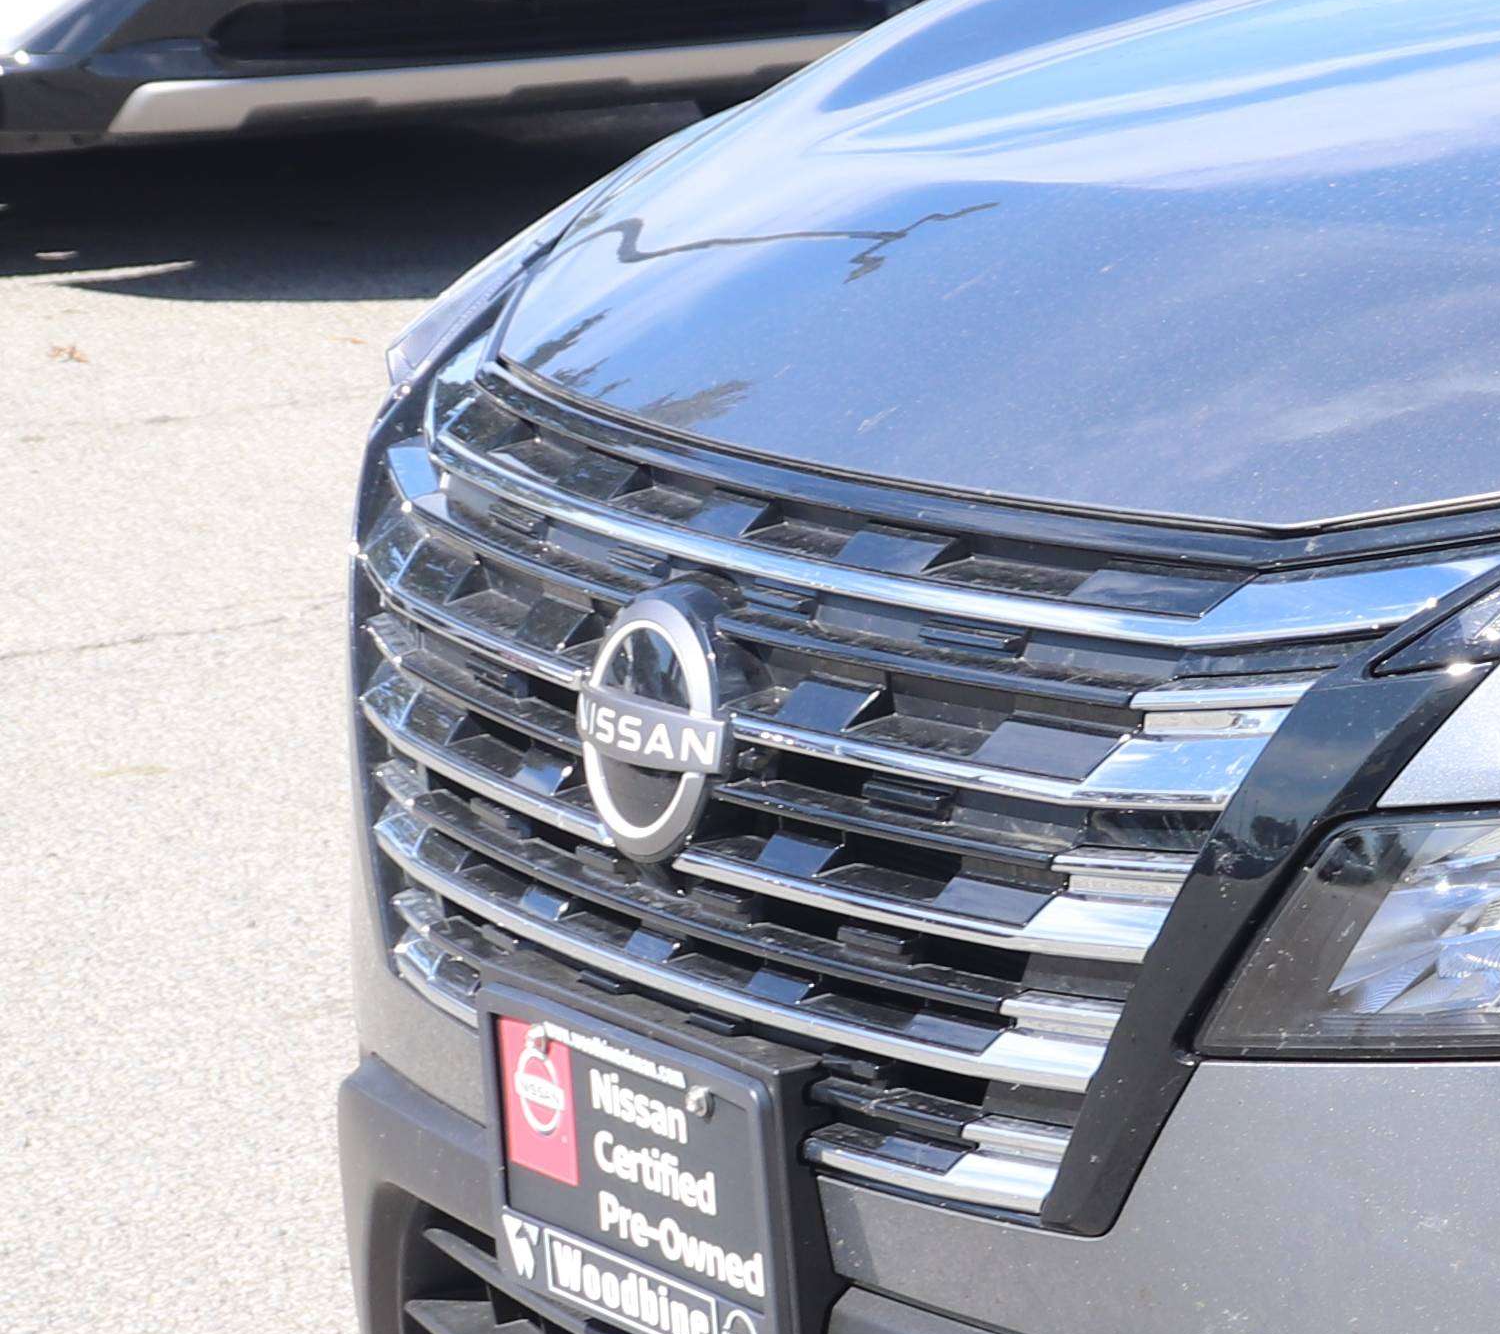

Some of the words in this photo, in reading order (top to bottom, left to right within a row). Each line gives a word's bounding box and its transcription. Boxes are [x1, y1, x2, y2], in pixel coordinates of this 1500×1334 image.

[580, 691, 716, 765] NISSAN
[590, 1069, 688, 1144] Nissan
[594, 1131, 717, 1215] Certified
[599, 1192, 765, 1296] Pre-Owned
